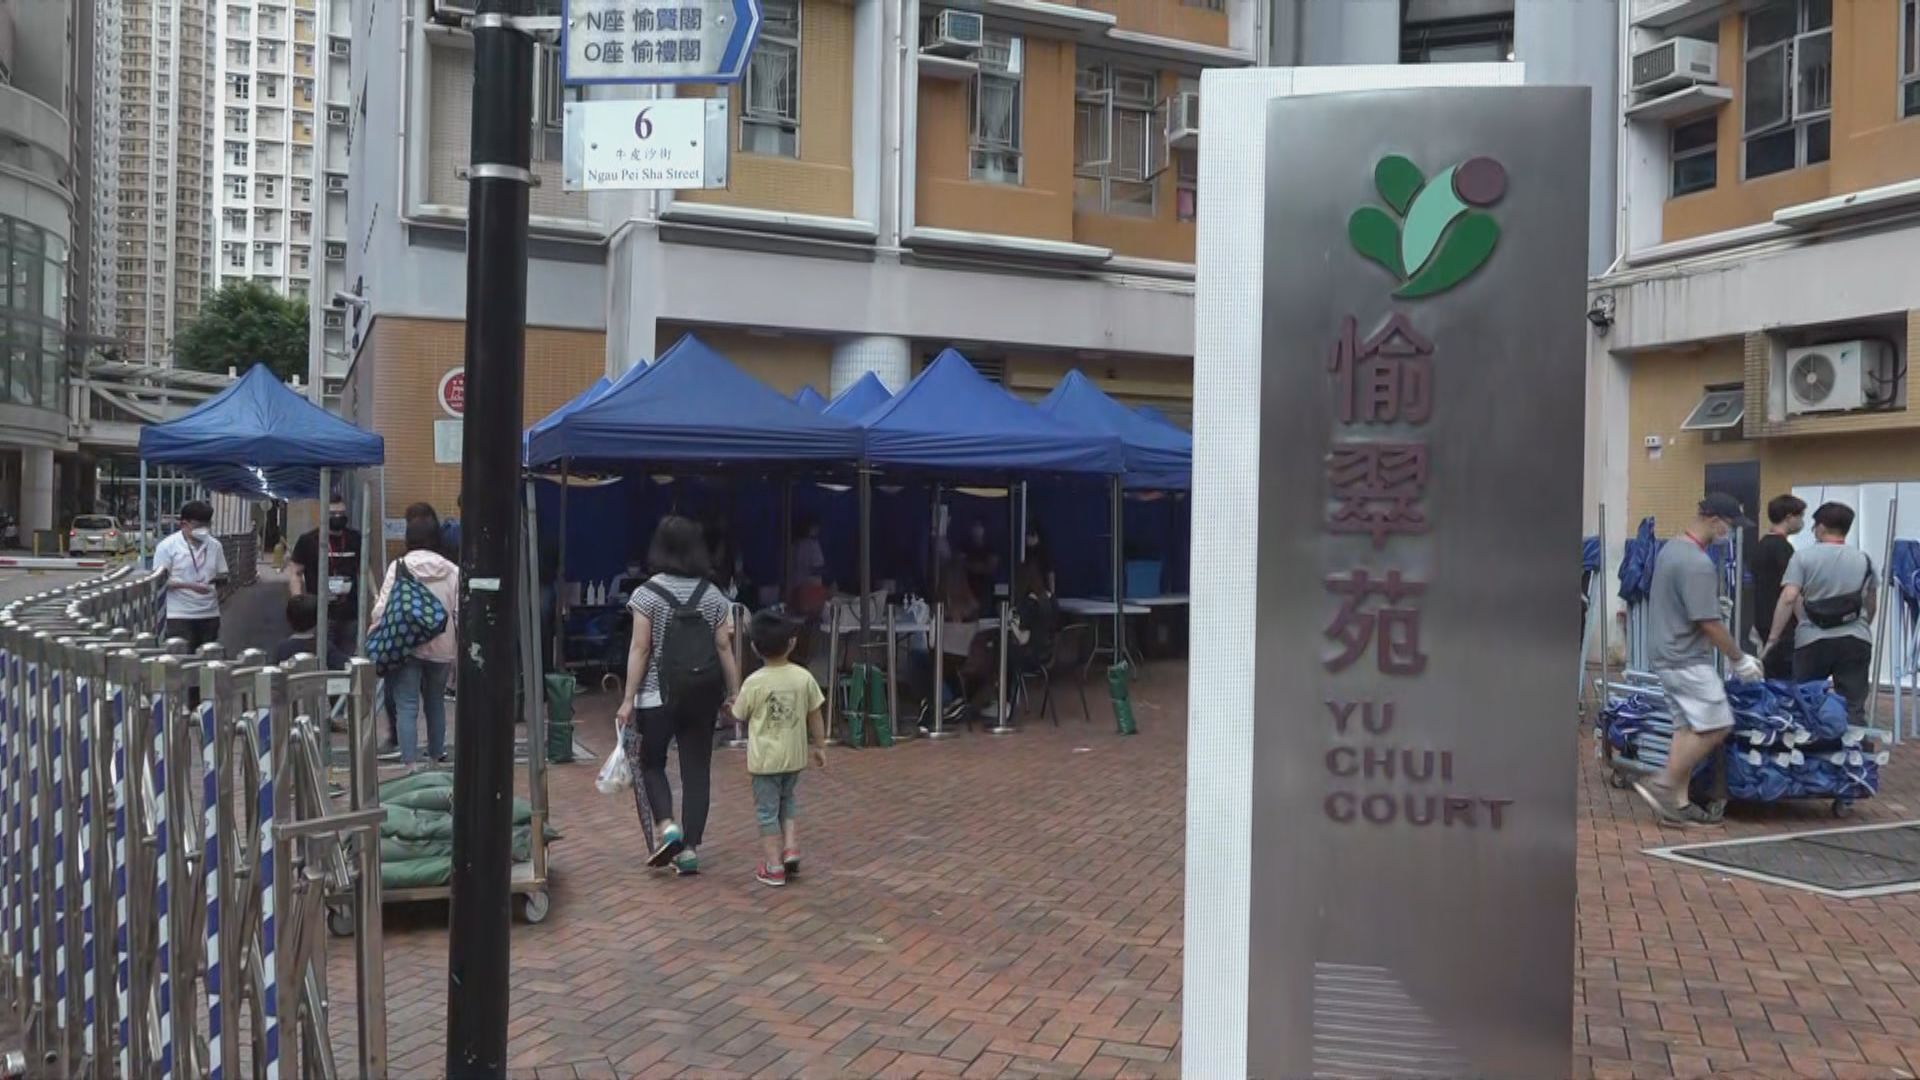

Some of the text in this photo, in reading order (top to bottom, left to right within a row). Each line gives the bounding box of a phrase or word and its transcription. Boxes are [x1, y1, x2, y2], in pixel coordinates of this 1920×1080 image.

[586, 9, 625, 32] N座
[584, 39, 701, 63] O座 愉禮閣
[634, 106, 653, 140] 6
[588, 167, 700, 183] Ngau Pei Sha Street
[1323, 313, 1433, 674] 愉翠苑
[1325, 700, 1395, 735] YU
[1325, 746, 1454, 783] CHUI
[1323, 790, 1514, 831] COURT
